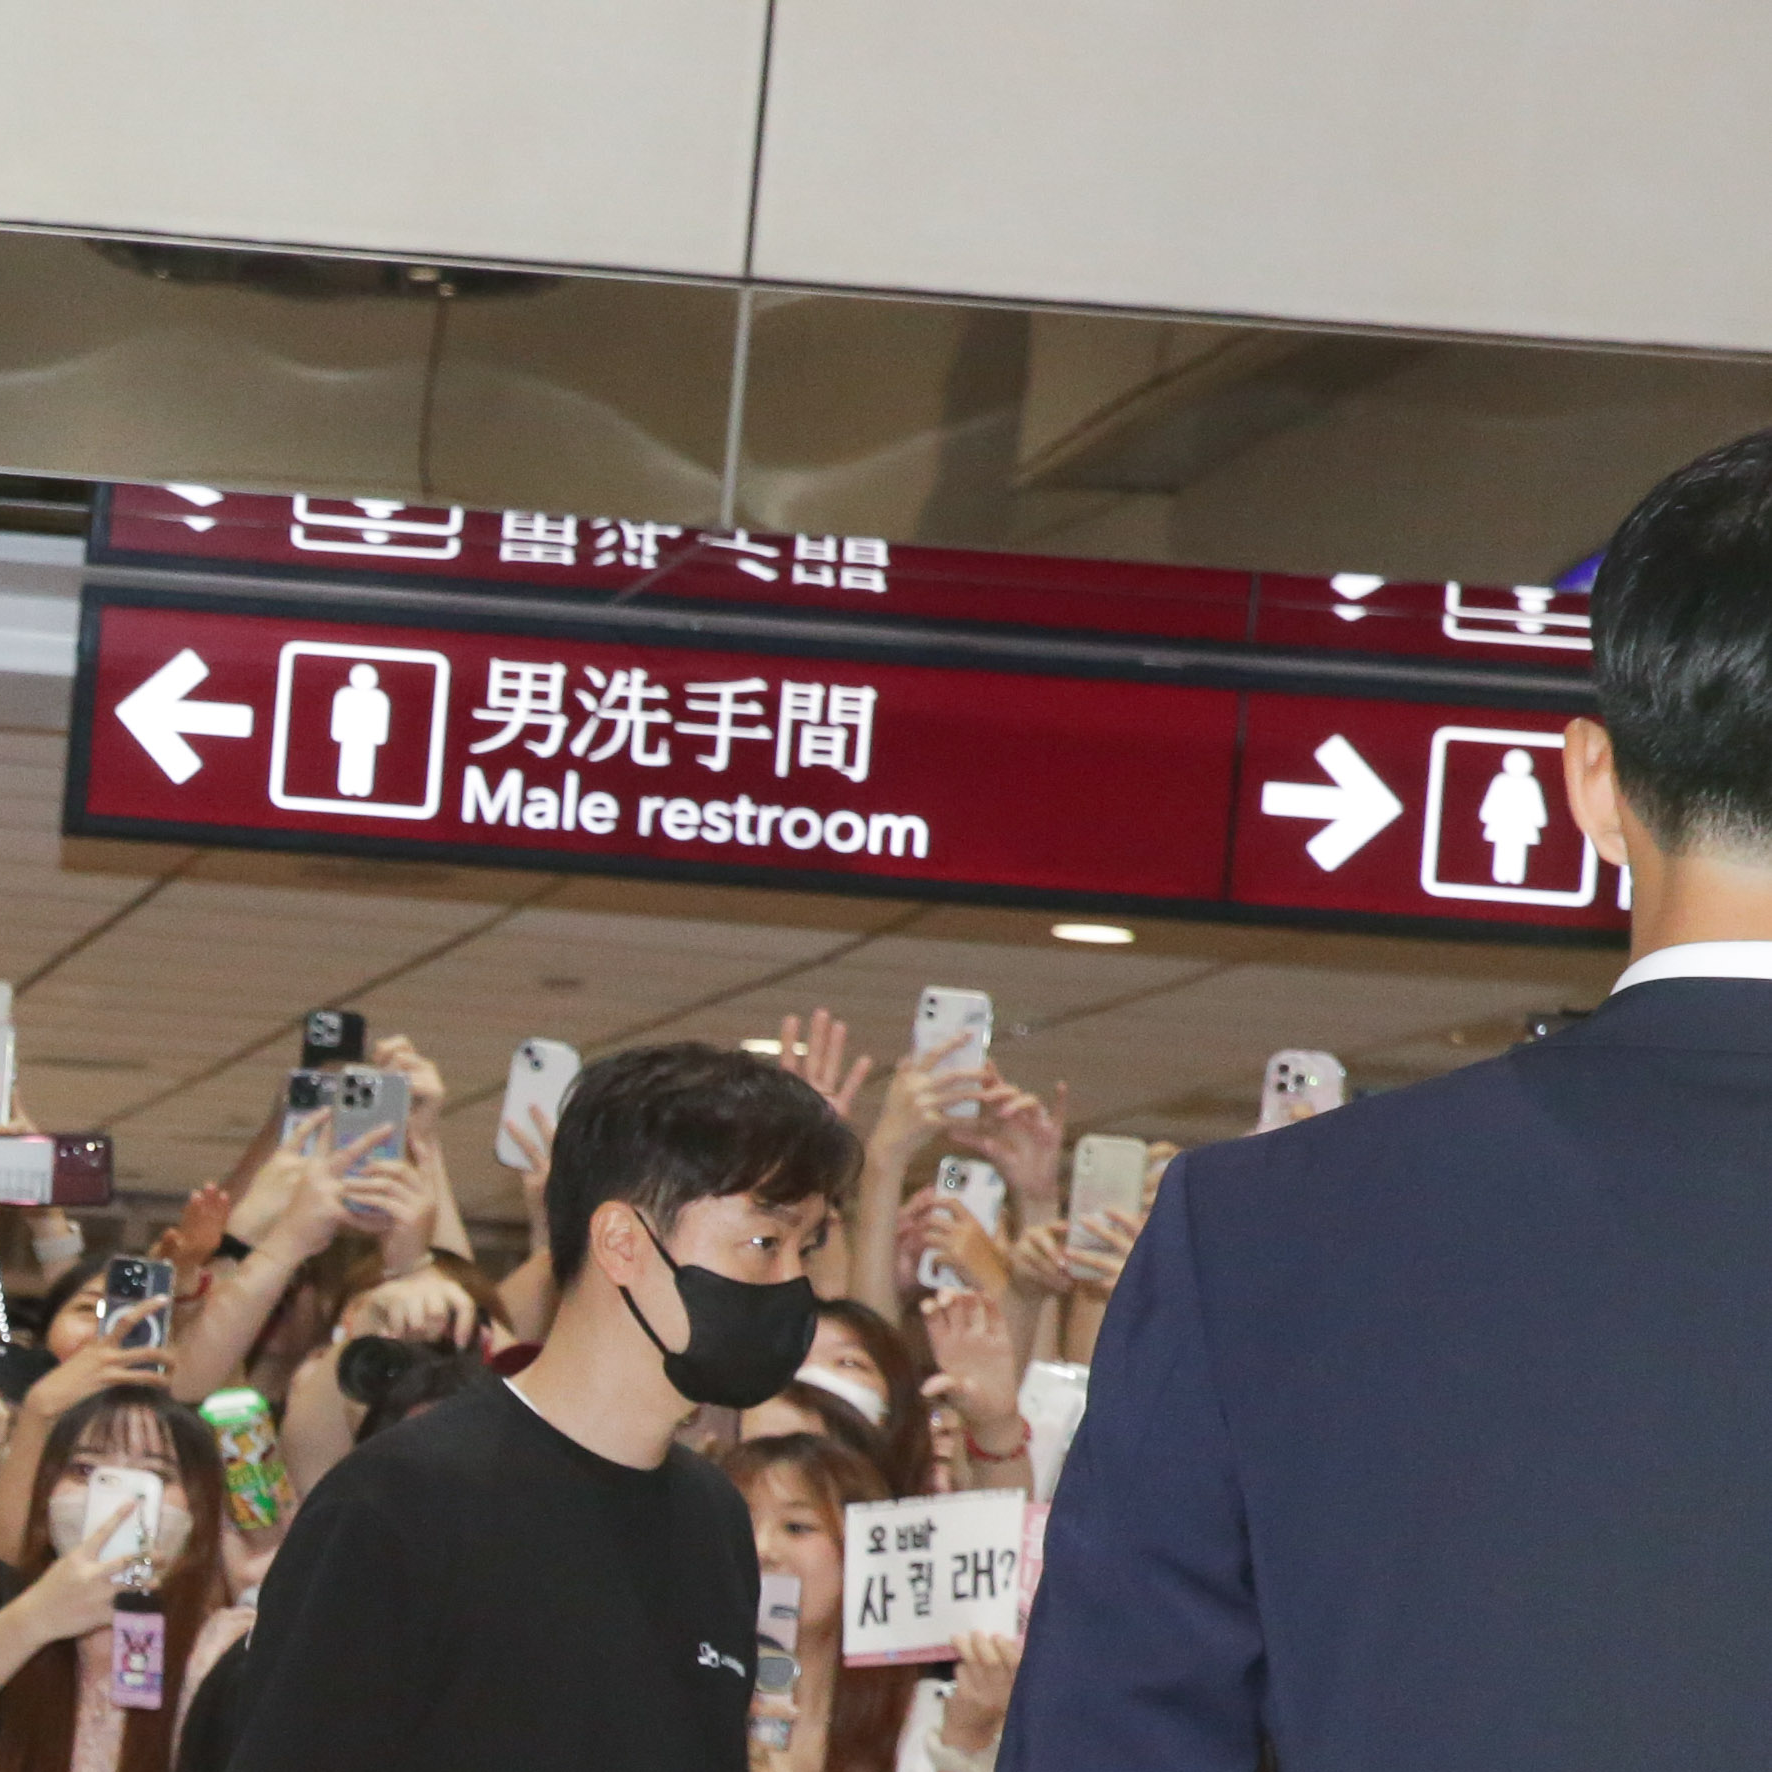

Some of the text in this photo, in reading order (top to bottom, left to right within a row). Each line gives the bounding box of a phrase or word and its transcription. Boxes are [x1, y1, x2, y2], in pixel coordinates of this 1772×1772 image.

[468, 657, 877, 783] 男洗手間
[461, 766, 930, 860] Male restroom
